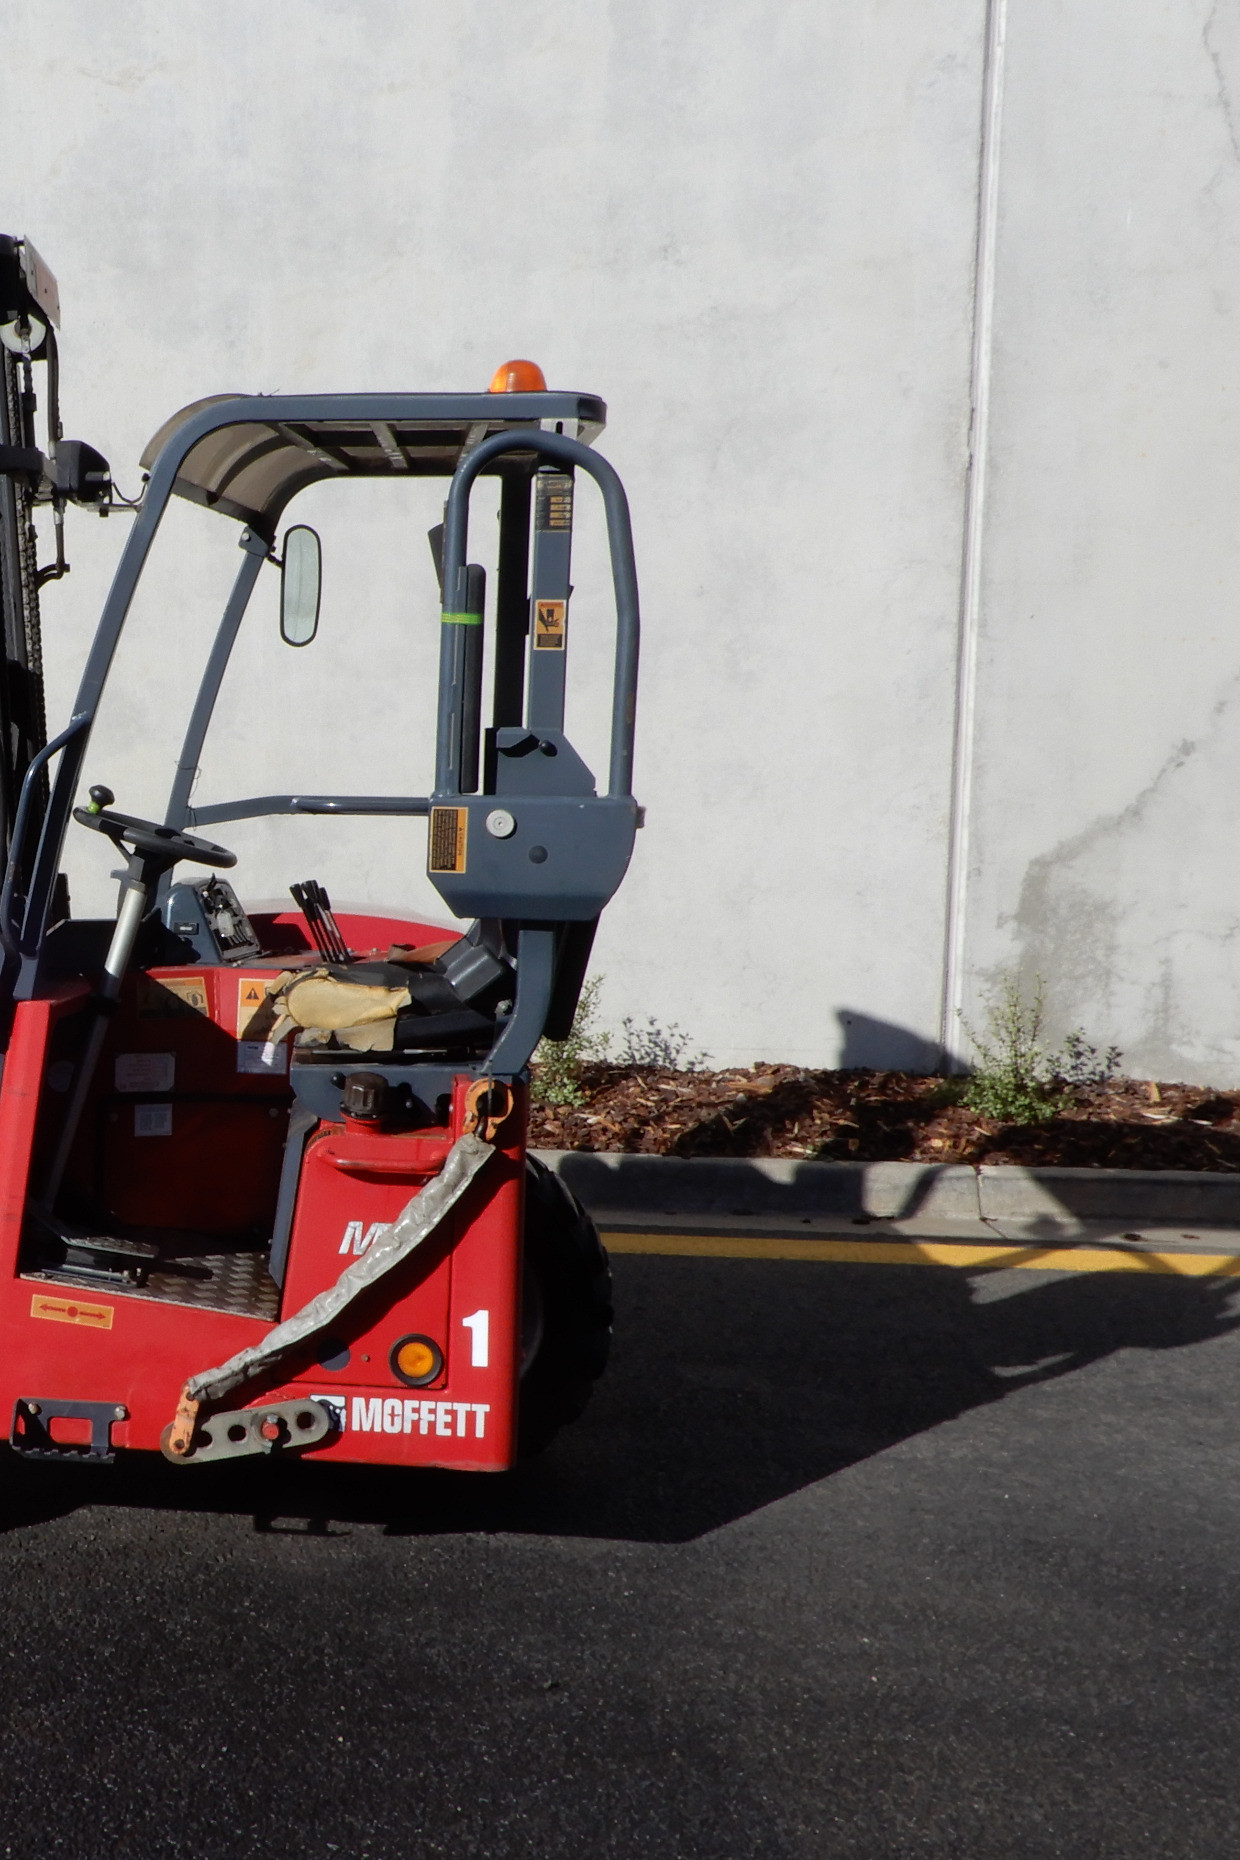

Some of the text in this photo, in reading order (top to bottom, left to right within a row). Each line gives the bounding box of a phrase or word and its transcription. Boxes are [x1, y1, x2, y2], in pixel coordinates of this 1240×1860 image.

[338, 1221, 393, 1256] M
[462, 1310, 489, 1367] 1
[352, 1397, 490, 1438] MOFFETT
